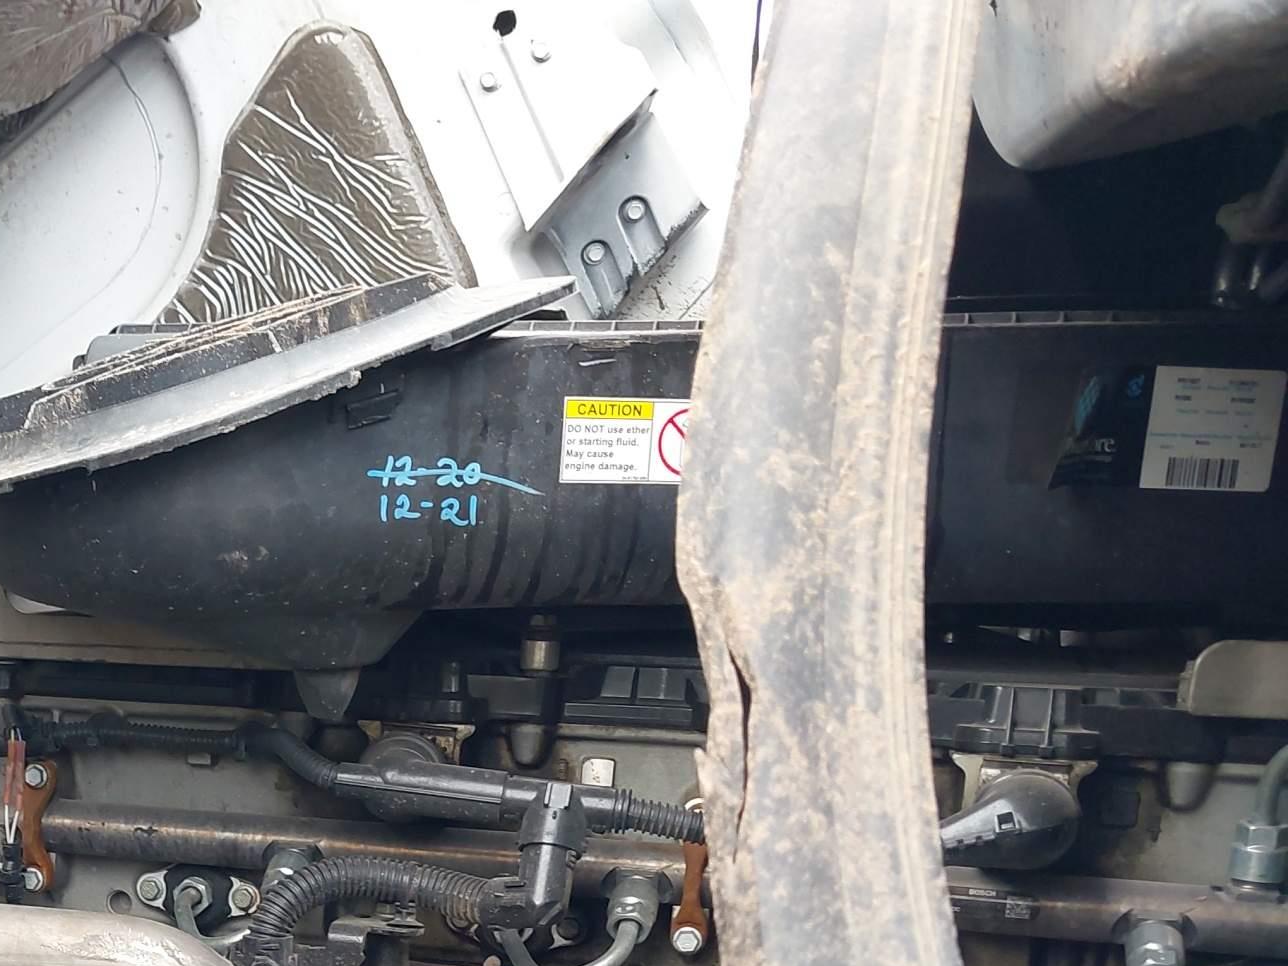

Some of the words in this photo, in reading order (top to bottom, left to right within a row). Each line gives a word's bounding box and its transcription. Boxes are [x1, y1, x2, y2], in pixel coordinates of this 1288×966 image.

[577, 403, 642, 416] CAUTION
[567, 425, 581, 433] DO
[584, 425, 604, 433] NOT
[627, 426, 650, 434] ether
[579, 438, 613, 448] starting
[616, 438, 639, 446] fluid.
[566, 449, 584, 459] May
[565, 463, 595, 471] engine
[598, 463, 637, 472] damage.
[380, 494, 478, 526] 12-21
